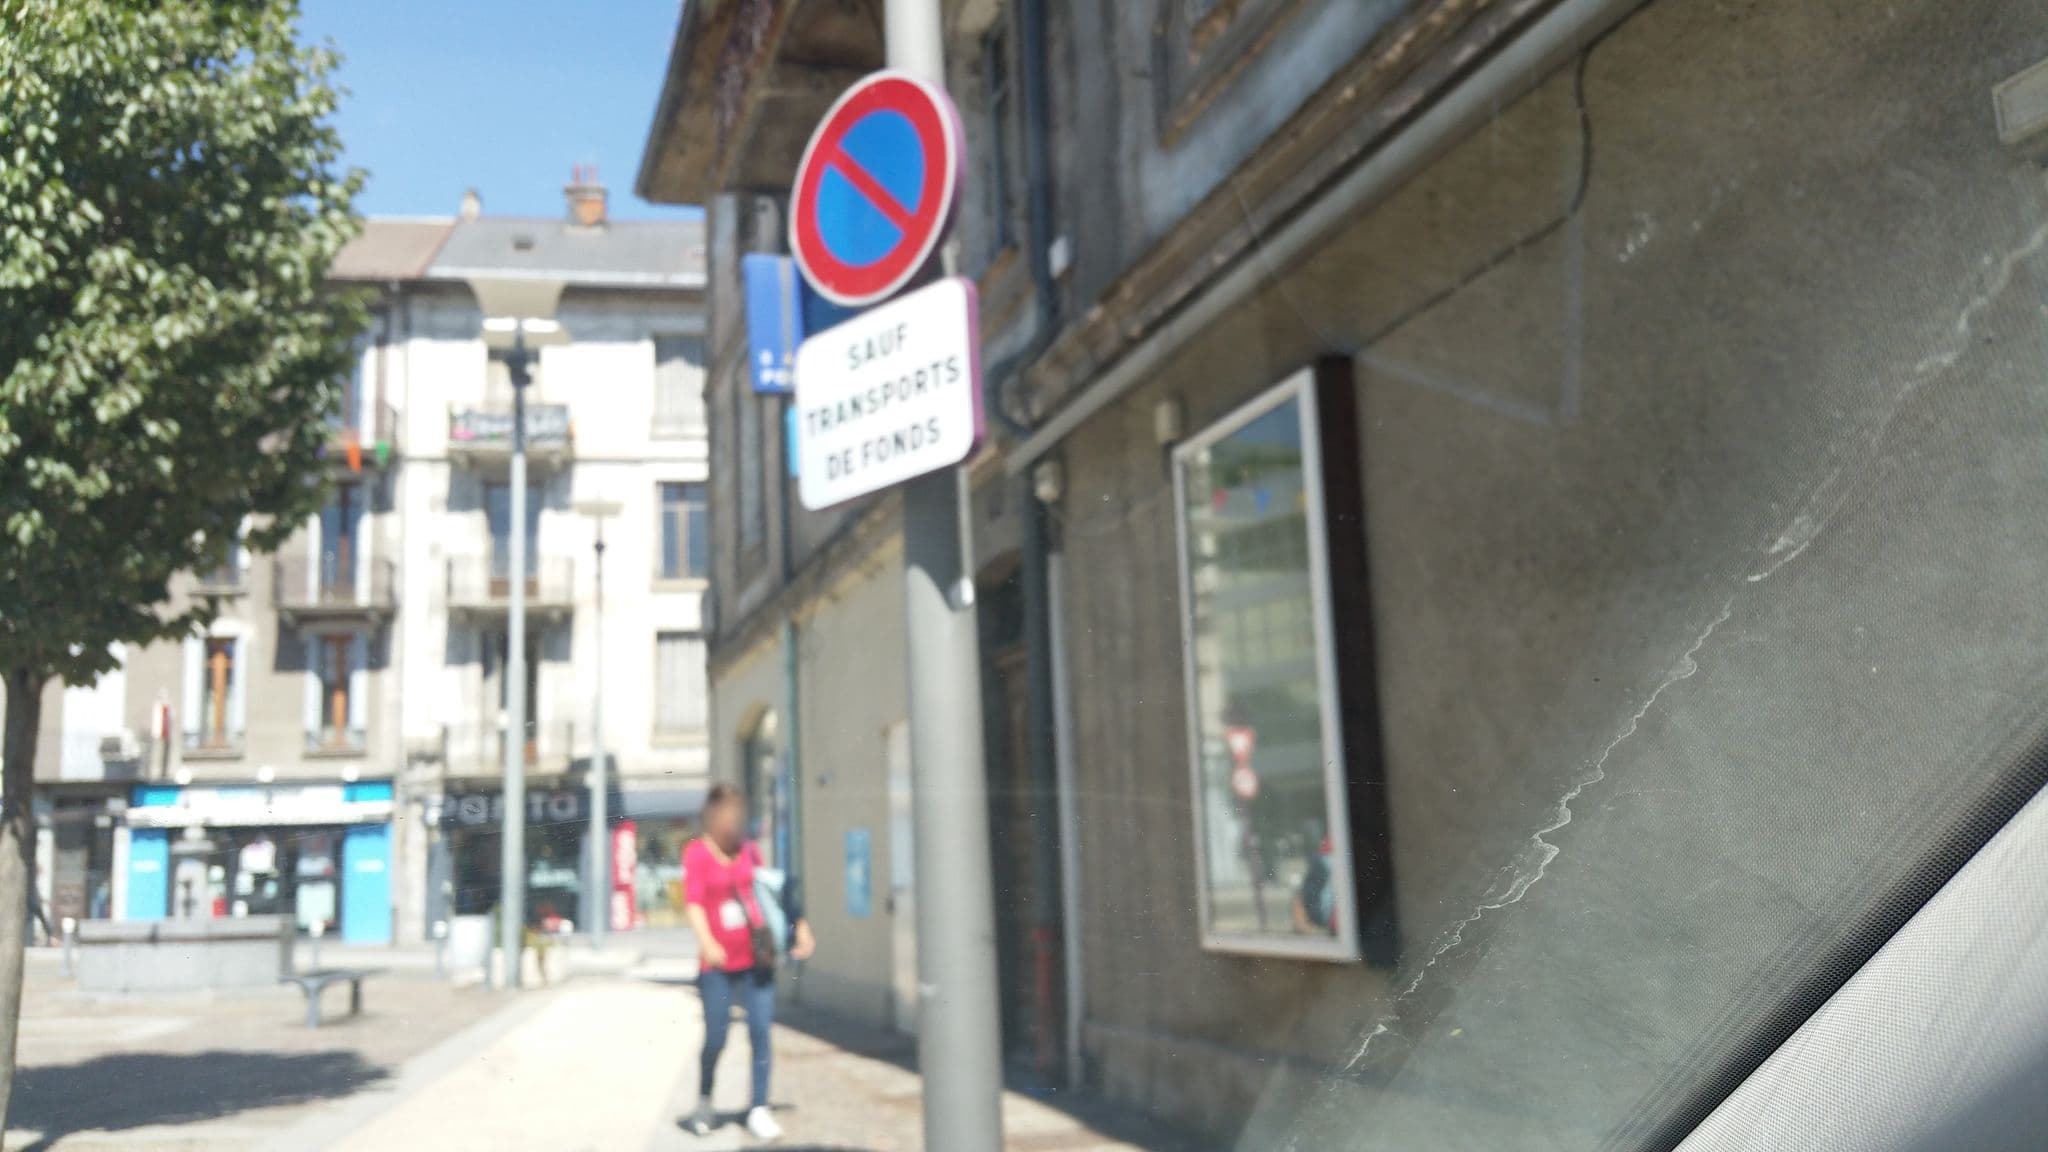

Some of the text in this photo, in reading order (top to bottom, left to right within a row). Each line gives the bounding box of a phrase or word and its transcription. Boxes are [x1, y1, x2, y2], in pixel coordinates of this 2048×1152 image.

[848, 322, 907, 370] SAUF
[805, 356, 960, 437] TRANSPORTS
[827, 416, 941, 480] DE FONDS
